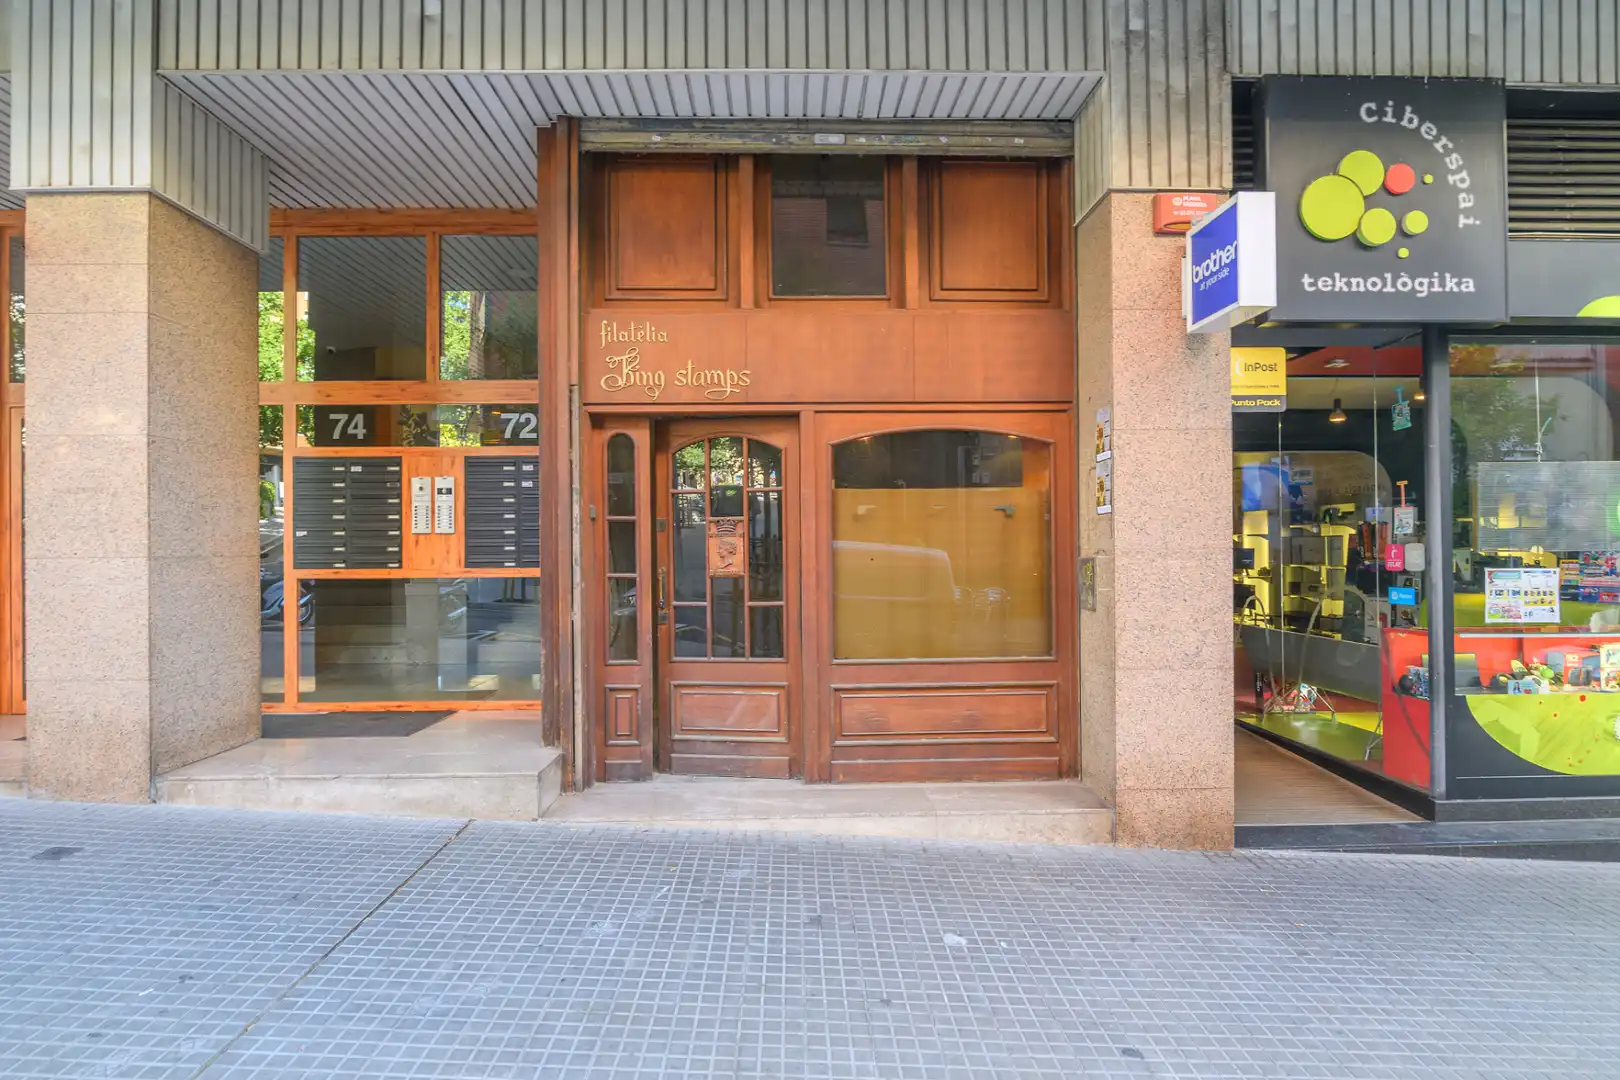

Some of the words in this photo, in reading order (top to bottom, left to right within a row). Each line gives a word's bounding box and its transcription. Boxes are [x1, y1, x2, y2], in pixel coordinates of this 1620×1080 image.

[1359, 100, 1481, 229] Ciberspai
[1192, 240, 1238, 283] brother
[1301, 271, 1476, 298] teknològika
[674, 359, 752, 400] stamps
[1244, 362, 1278, 372] InPost
[1256, 399, 1281, 407] Pack
[329, 413, 367, 440] 74
[500, 412, 538, 439] 72
